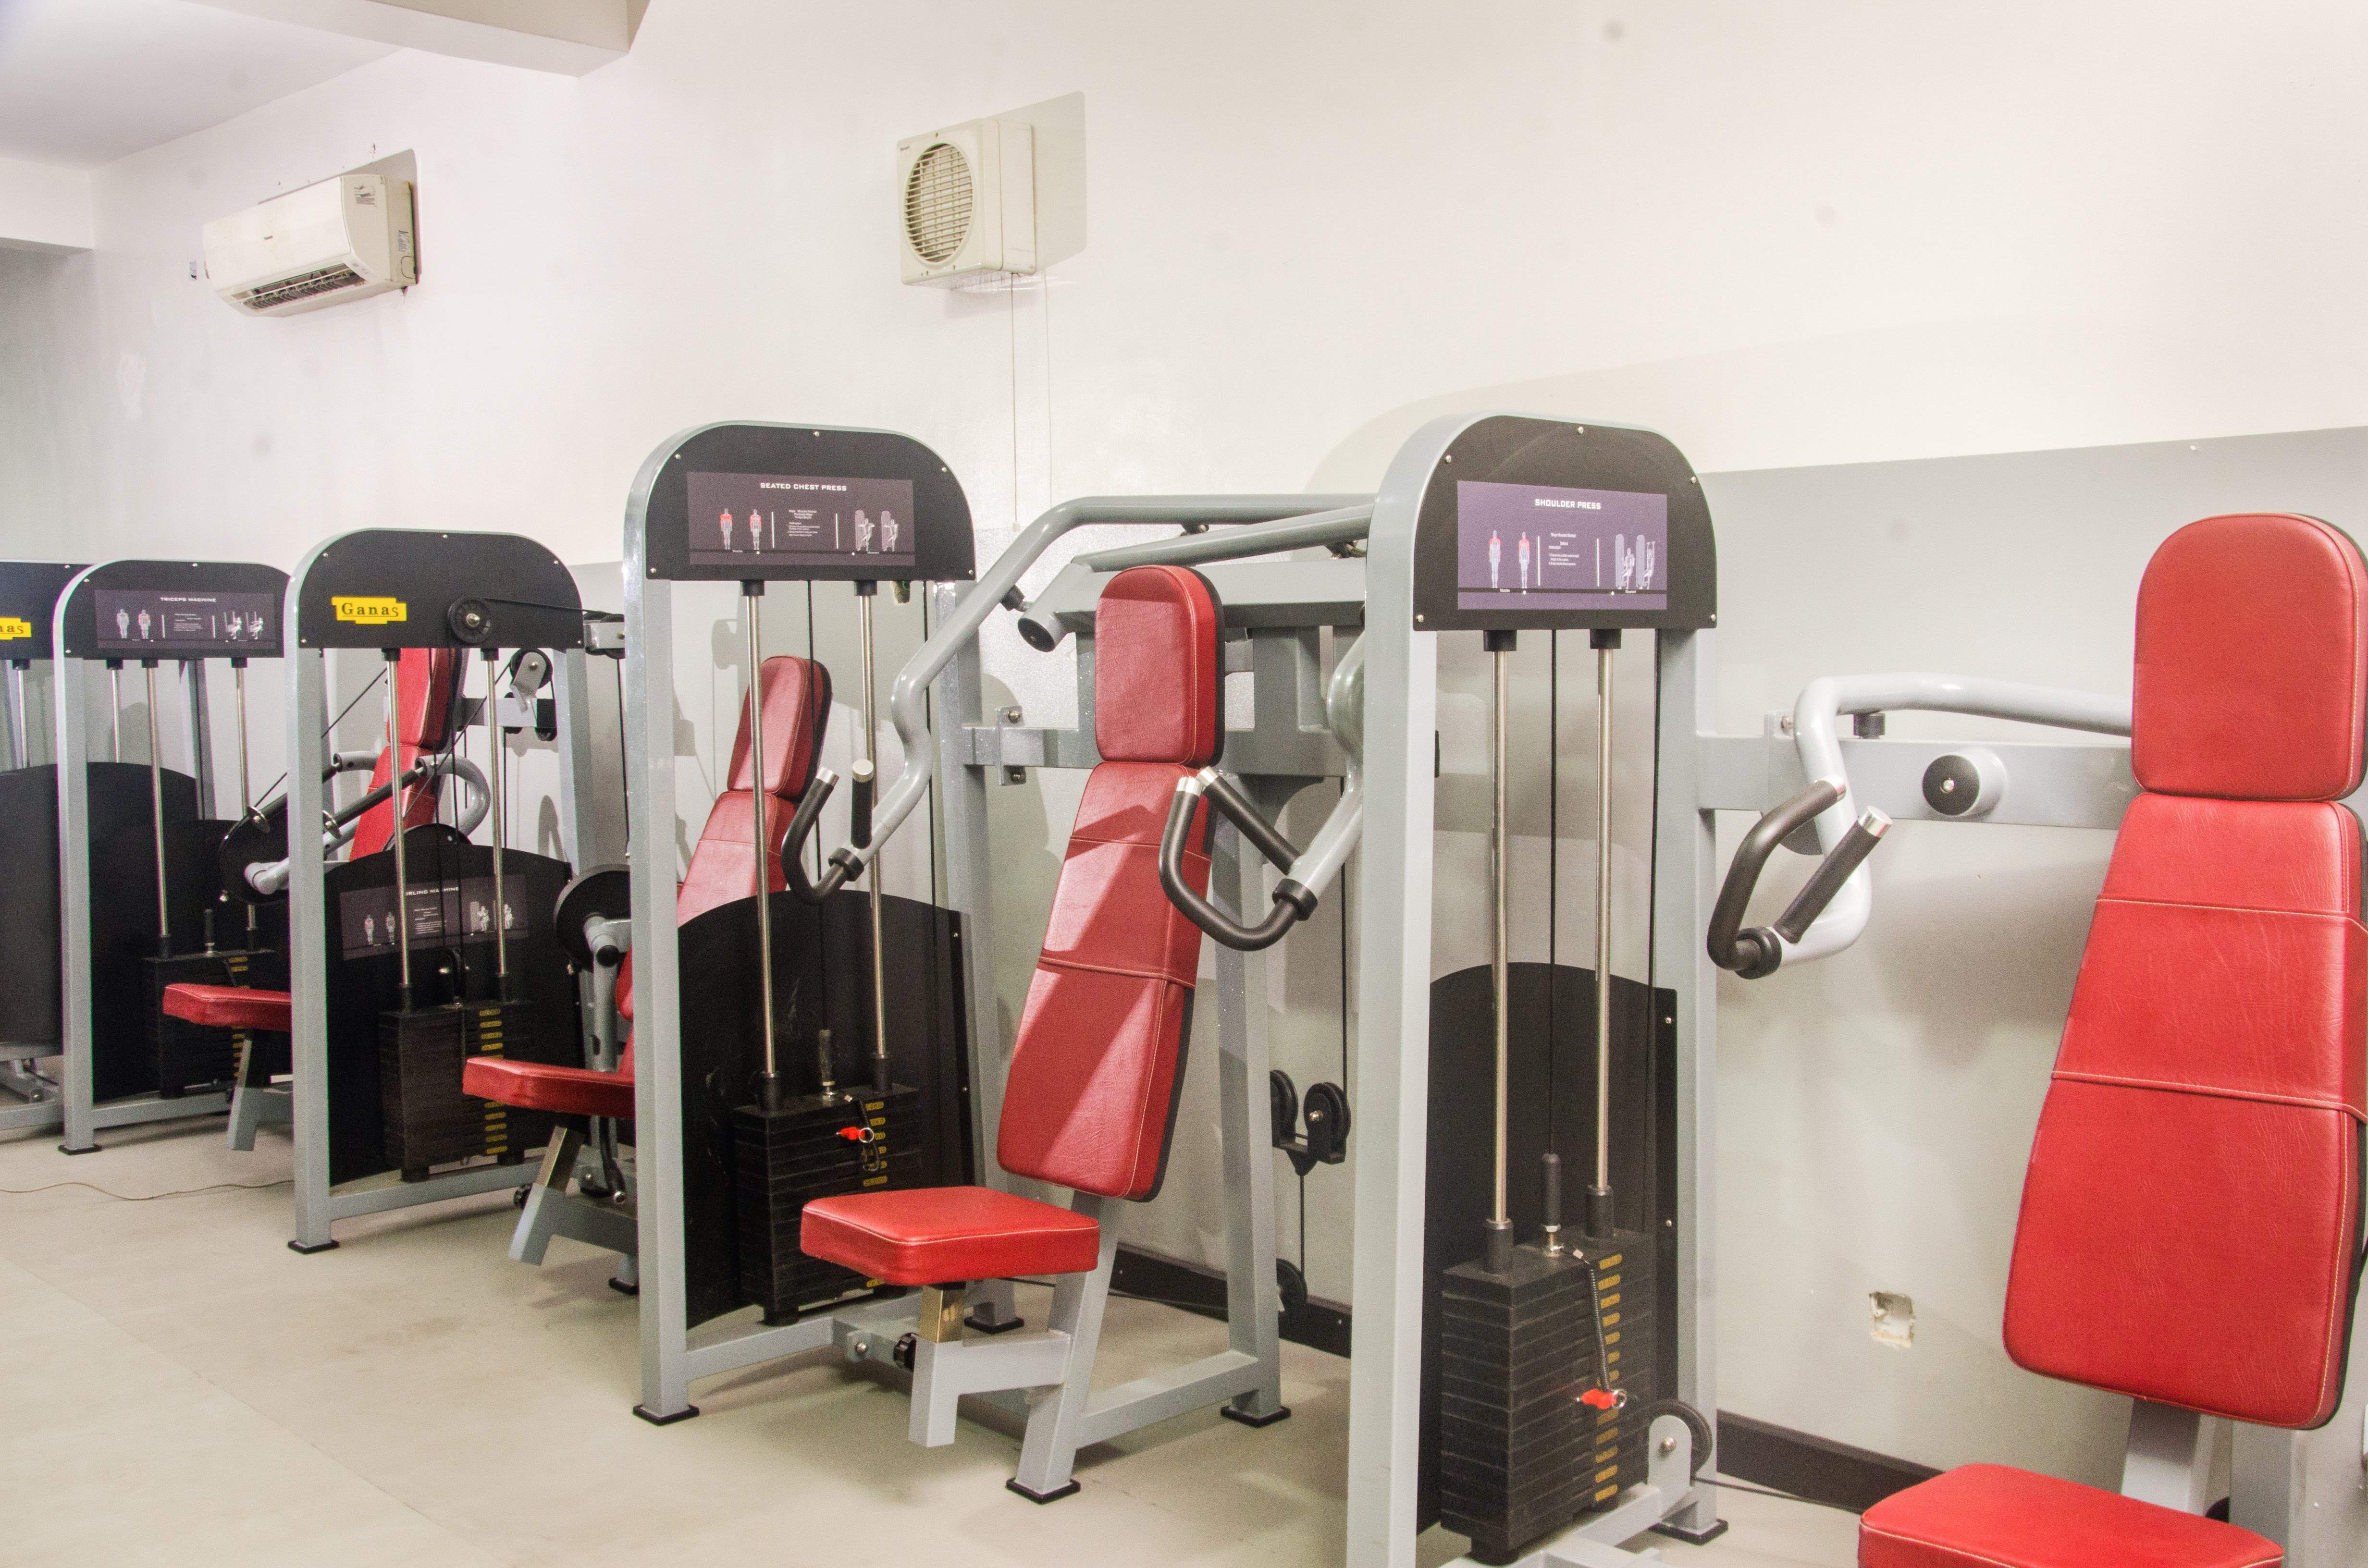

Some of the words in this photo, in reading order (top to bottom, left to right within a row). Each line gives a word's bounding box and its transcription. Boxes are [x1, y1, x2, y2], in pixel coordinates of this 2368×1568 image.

[1535, 499, 1575, 508] SHOULDER
[1578, 501, 1601, 510] PRESS
[342, 602, 398, 617] Ganas
